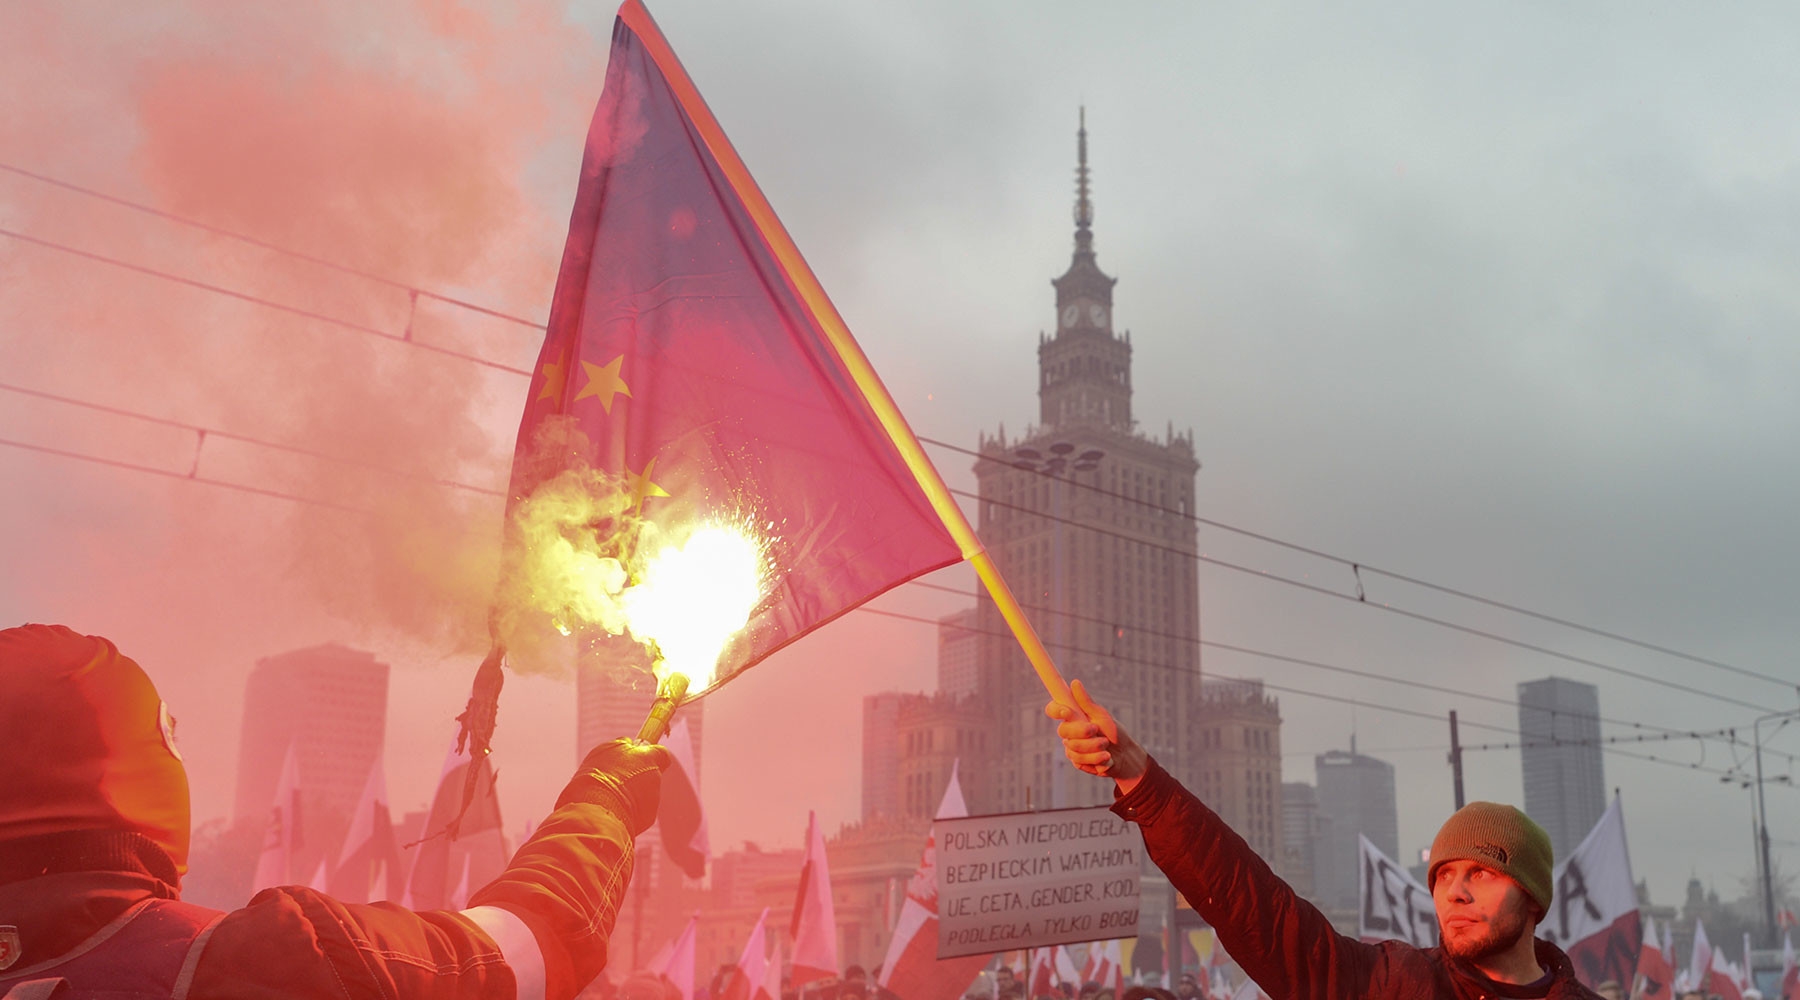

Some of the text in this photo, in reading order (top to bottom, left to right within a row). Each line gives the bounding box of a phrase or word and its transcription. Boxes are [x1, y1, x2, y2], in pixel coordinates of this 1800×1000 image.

[944, 829, 1009, 851] POLSKA
[946, 856, 1052, 884] BEZPIECKIM
[1043, 914, 1092, 935] TYLKO
[1099, 909, 1140, 930] BOGU
